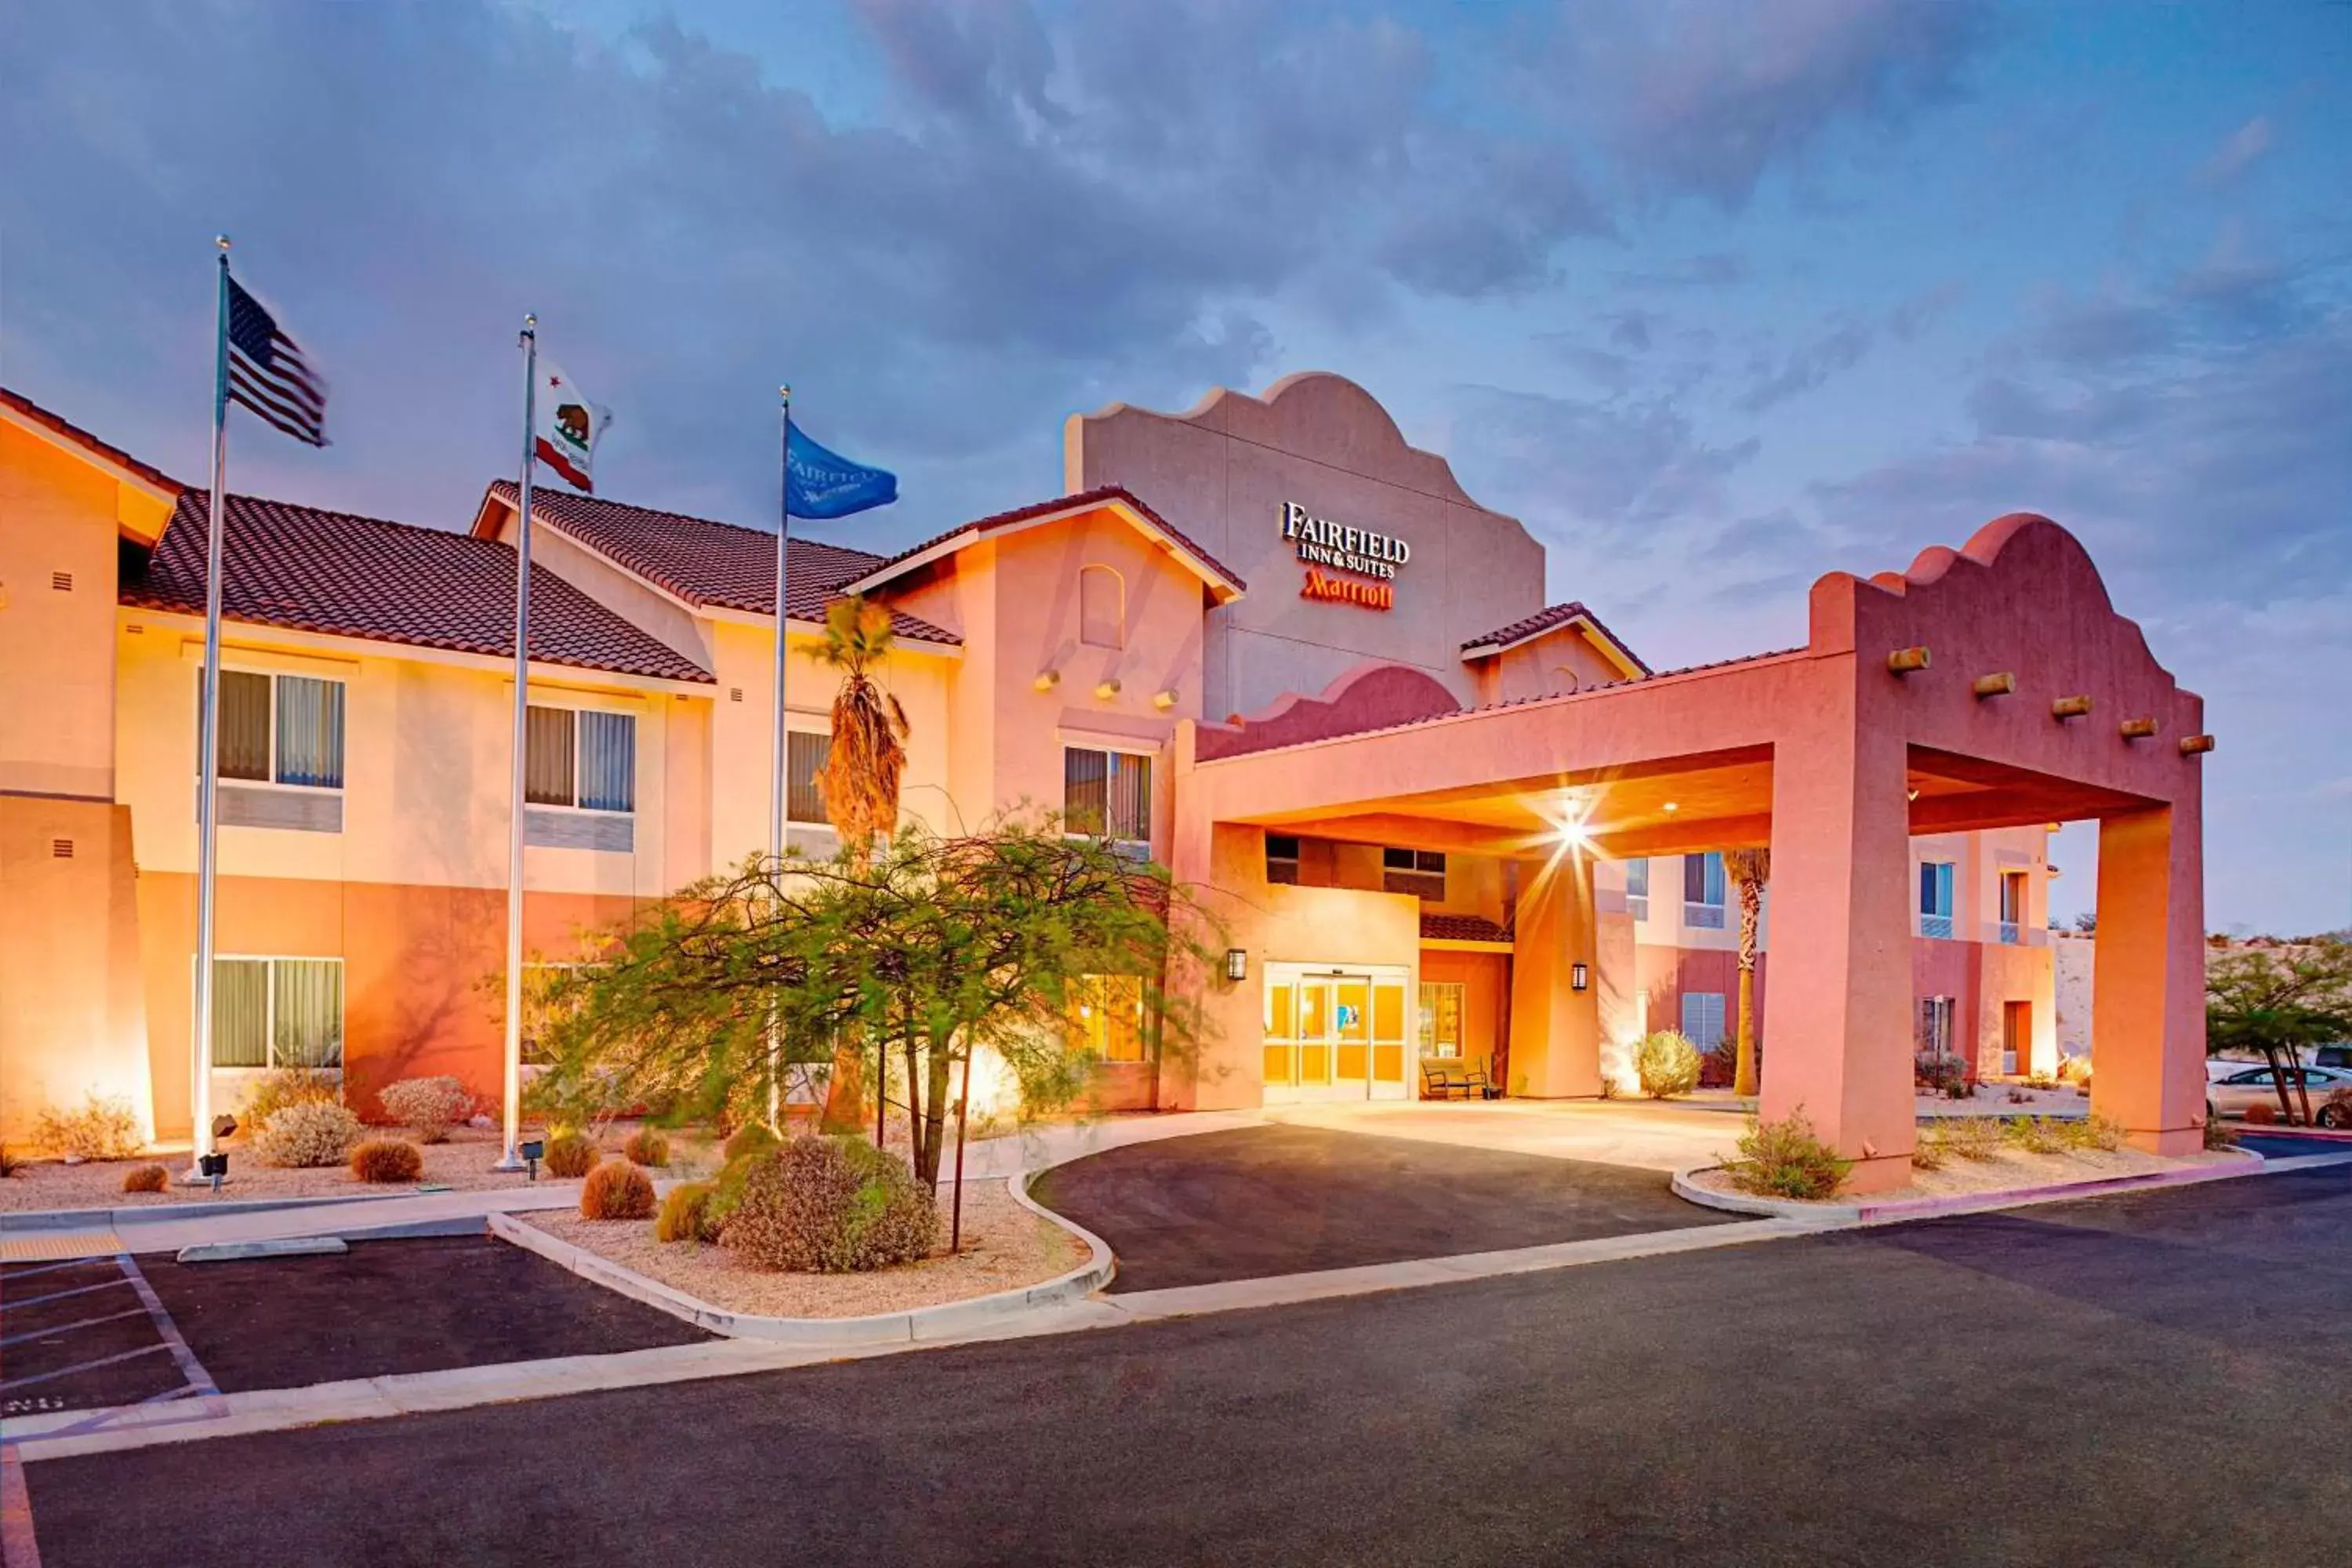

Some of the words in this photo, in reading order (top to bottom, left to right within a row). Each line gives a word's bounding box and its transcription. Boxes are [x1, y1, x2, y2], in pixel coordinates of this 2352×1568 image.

[1282, 501, 1410, 564] FAIRFIELD
[1300, 543, 1332, 564] INN
[1346, 554, 1395, 579] SUITES
[1304, 568, 1392, 608] Marriott
